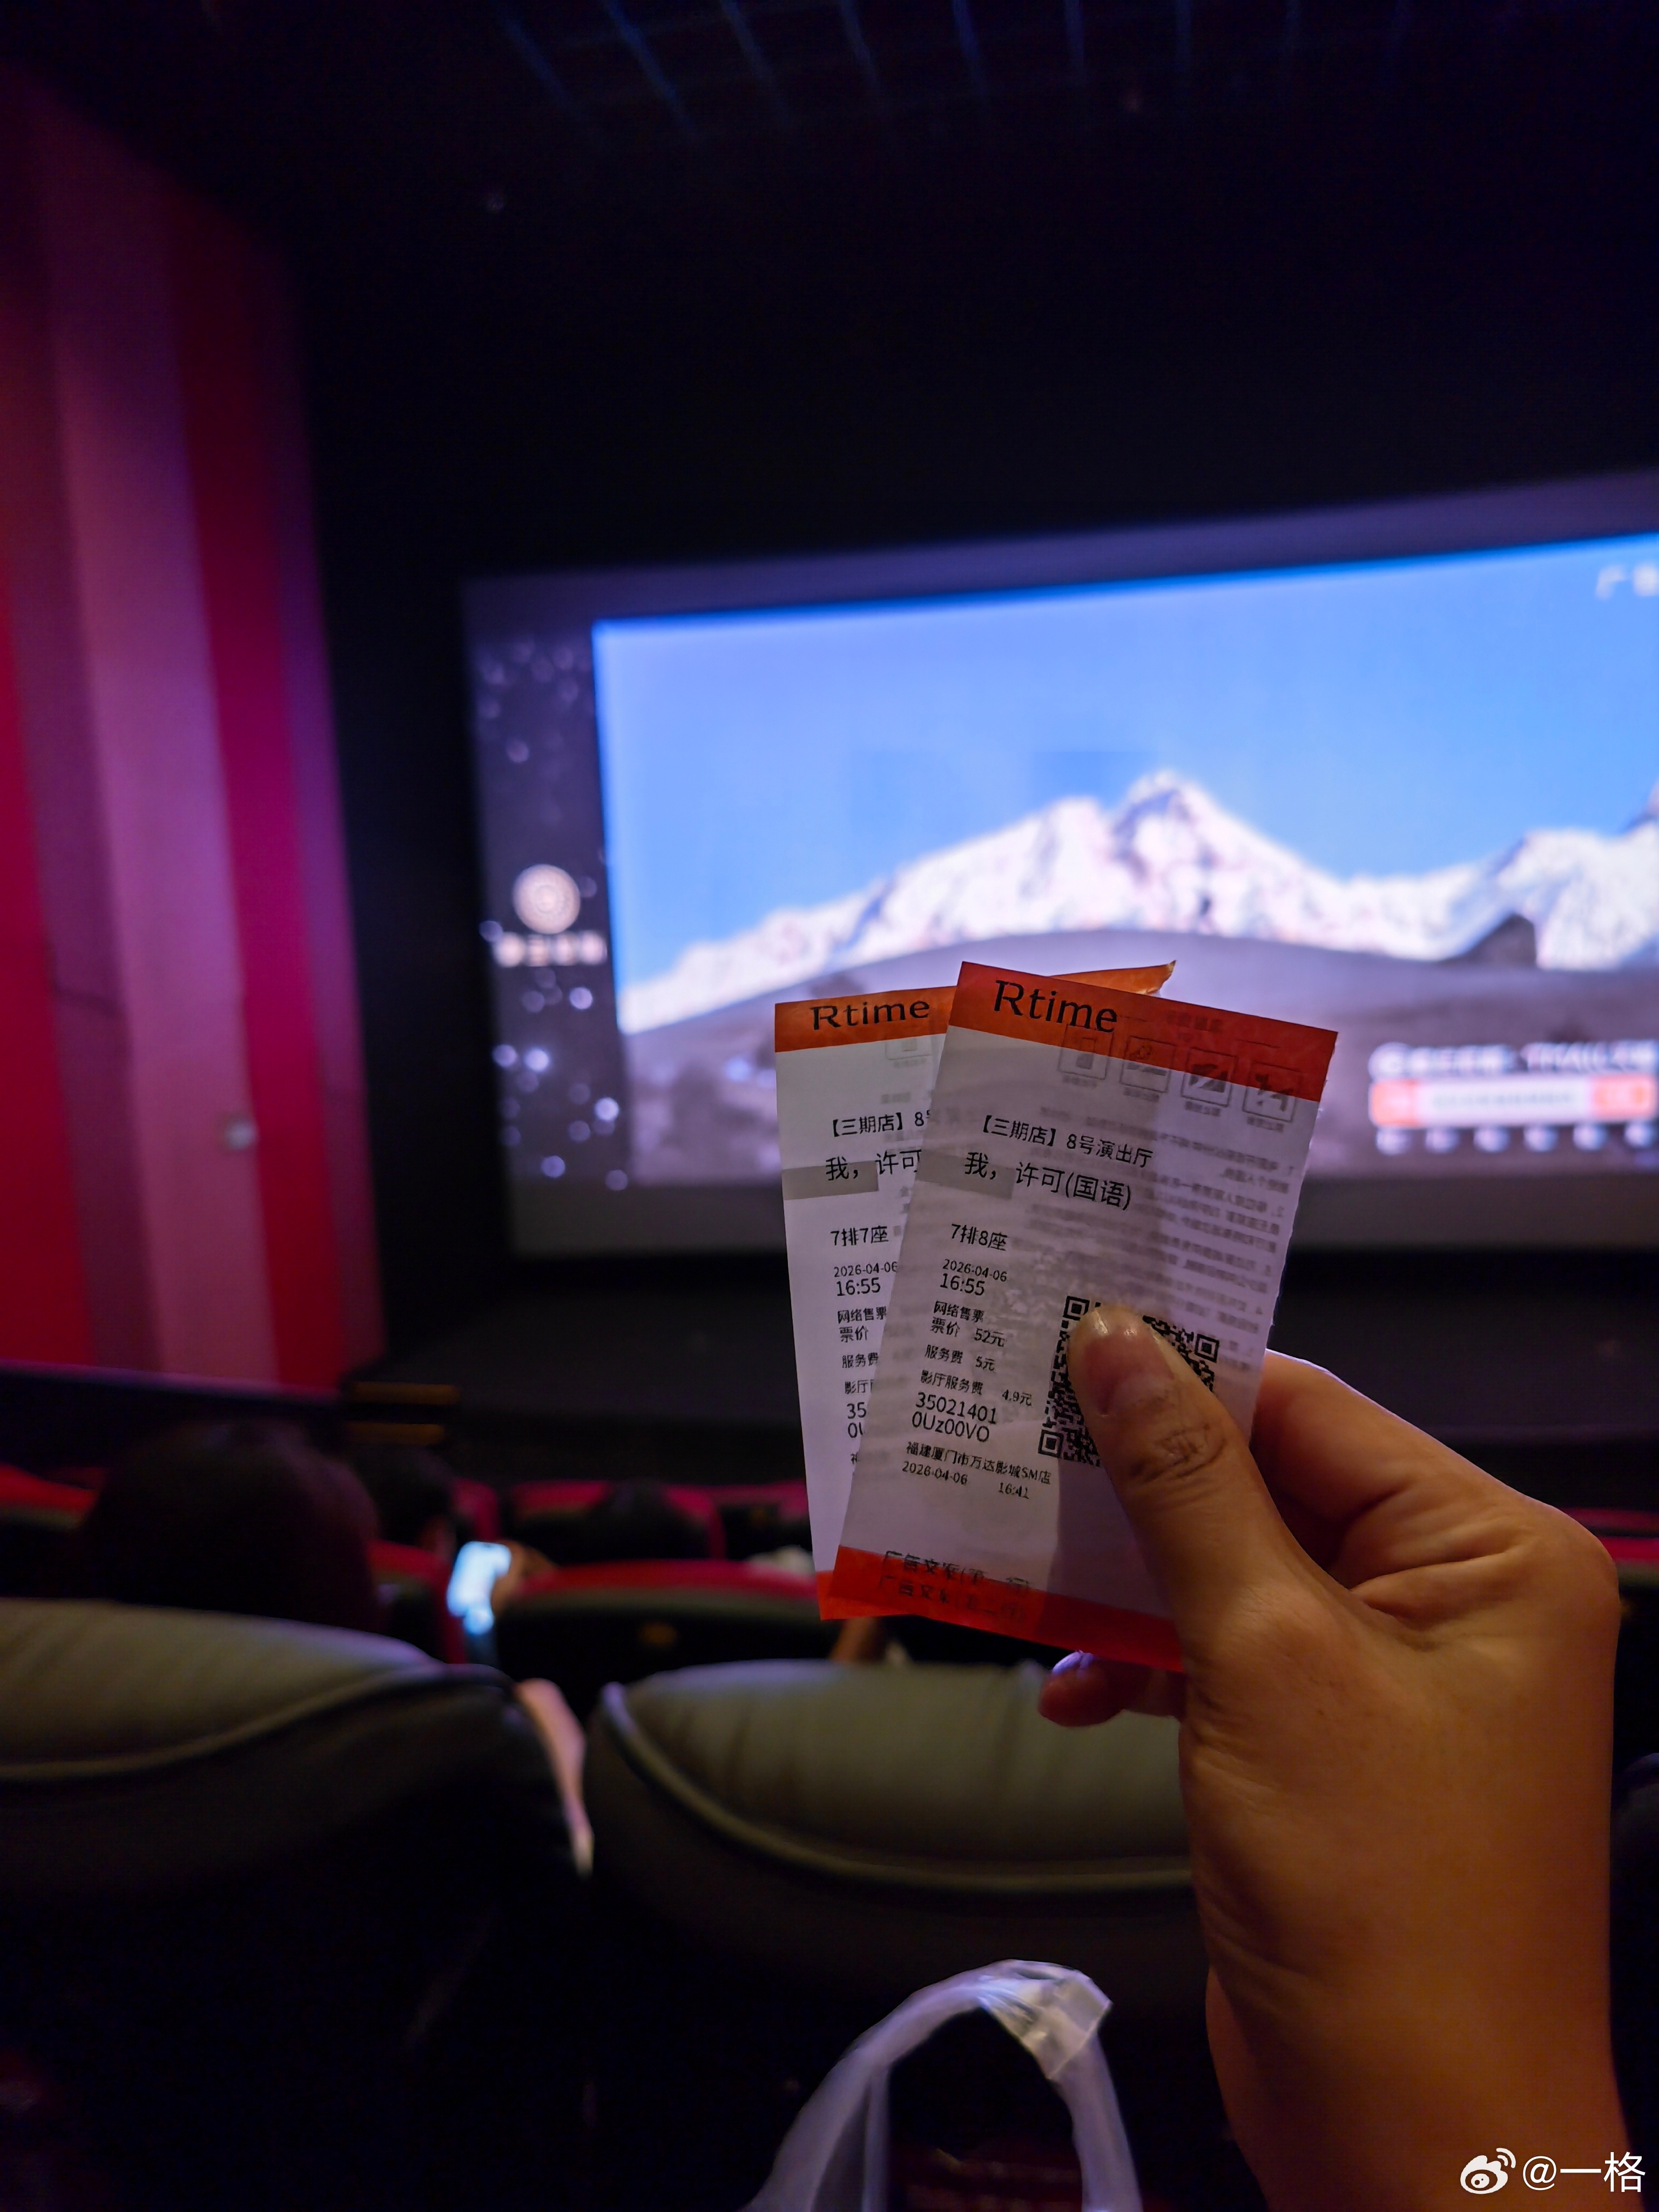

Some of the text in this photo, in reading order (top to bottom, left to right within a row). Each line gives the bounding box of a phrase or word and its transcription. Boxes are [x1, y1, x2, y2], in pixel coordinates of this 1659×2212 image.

[810, 1001, 930, 1030] Rtime
[994, 980, 1117, 1033] Rtime
[830, 1225, 889, 1246] 7排7座
[951, 1223, 1008, 1251] 7排8座
[834, 1261, 898, 1278] 2026-04-06
[942, 1259, 1007, 1282] 2026-04-06
[837, 1277, 881, 1296] 16:55
[940, 1273, 985, 1296] 16:55
[838, 1306, 887, 1324] 网络售票
[933, 1300, 985, 1323] 网络售票
[839, 1325, 869, 1343] 票价
[930, 1317, 1006, 1347] 票价 52元
[842, 1352, 879, 1368] 服务费
[925, 1344, 995, 1372] 服务费 5元
[845, 1379, 874, 1394] 影厅
[920, 1370, 1033, 1407] 影厅服务费 4.9元
[846, 1402, 867, 1419] 35
[915, 1392, 997, 1425] 35021401
[902, 1461, 1030, 1500] 2026-04-06 16:41
